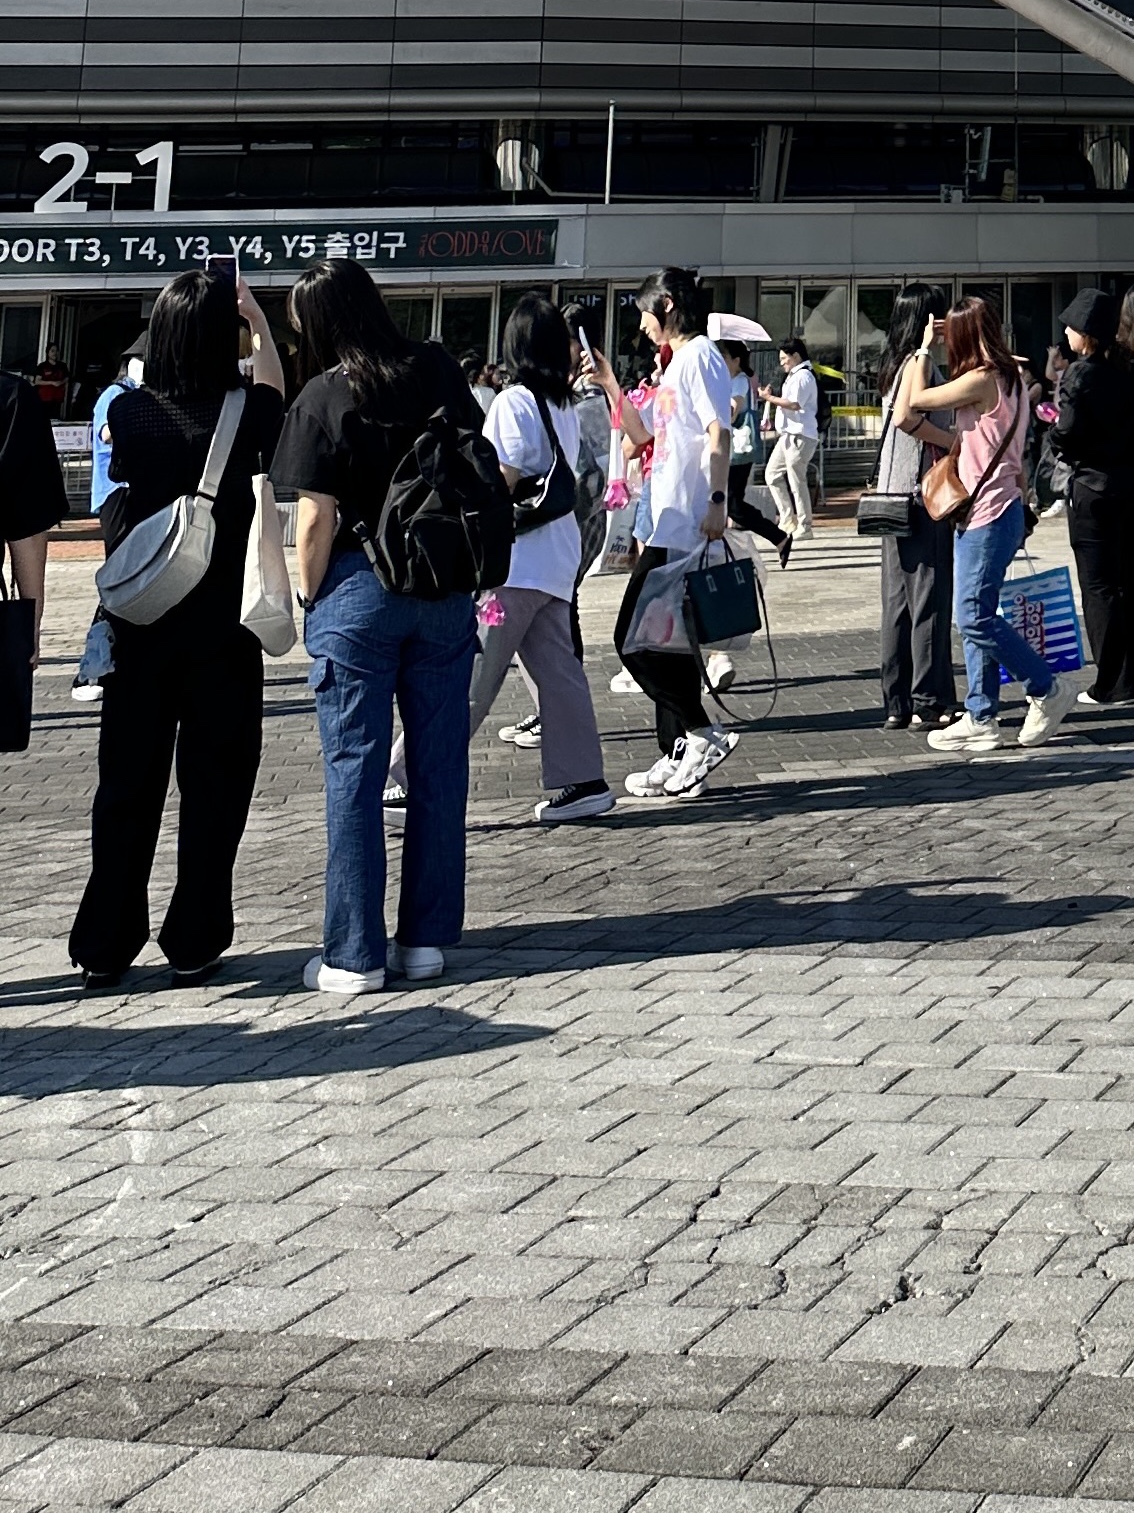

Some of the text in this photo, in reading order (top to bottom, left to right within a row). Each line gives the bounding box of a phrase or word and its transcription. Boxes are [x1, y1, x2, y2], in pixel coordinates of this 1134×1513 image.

[34, 140, 174, 214] 2-1
[64, 238, 111, 267] T3,
[120, 237, 167, 266] T4,
[228, 235, 273, 265] Y4,
[281, 234, 317, 259] Y5
[324, 231, 407, 260] 출입구
